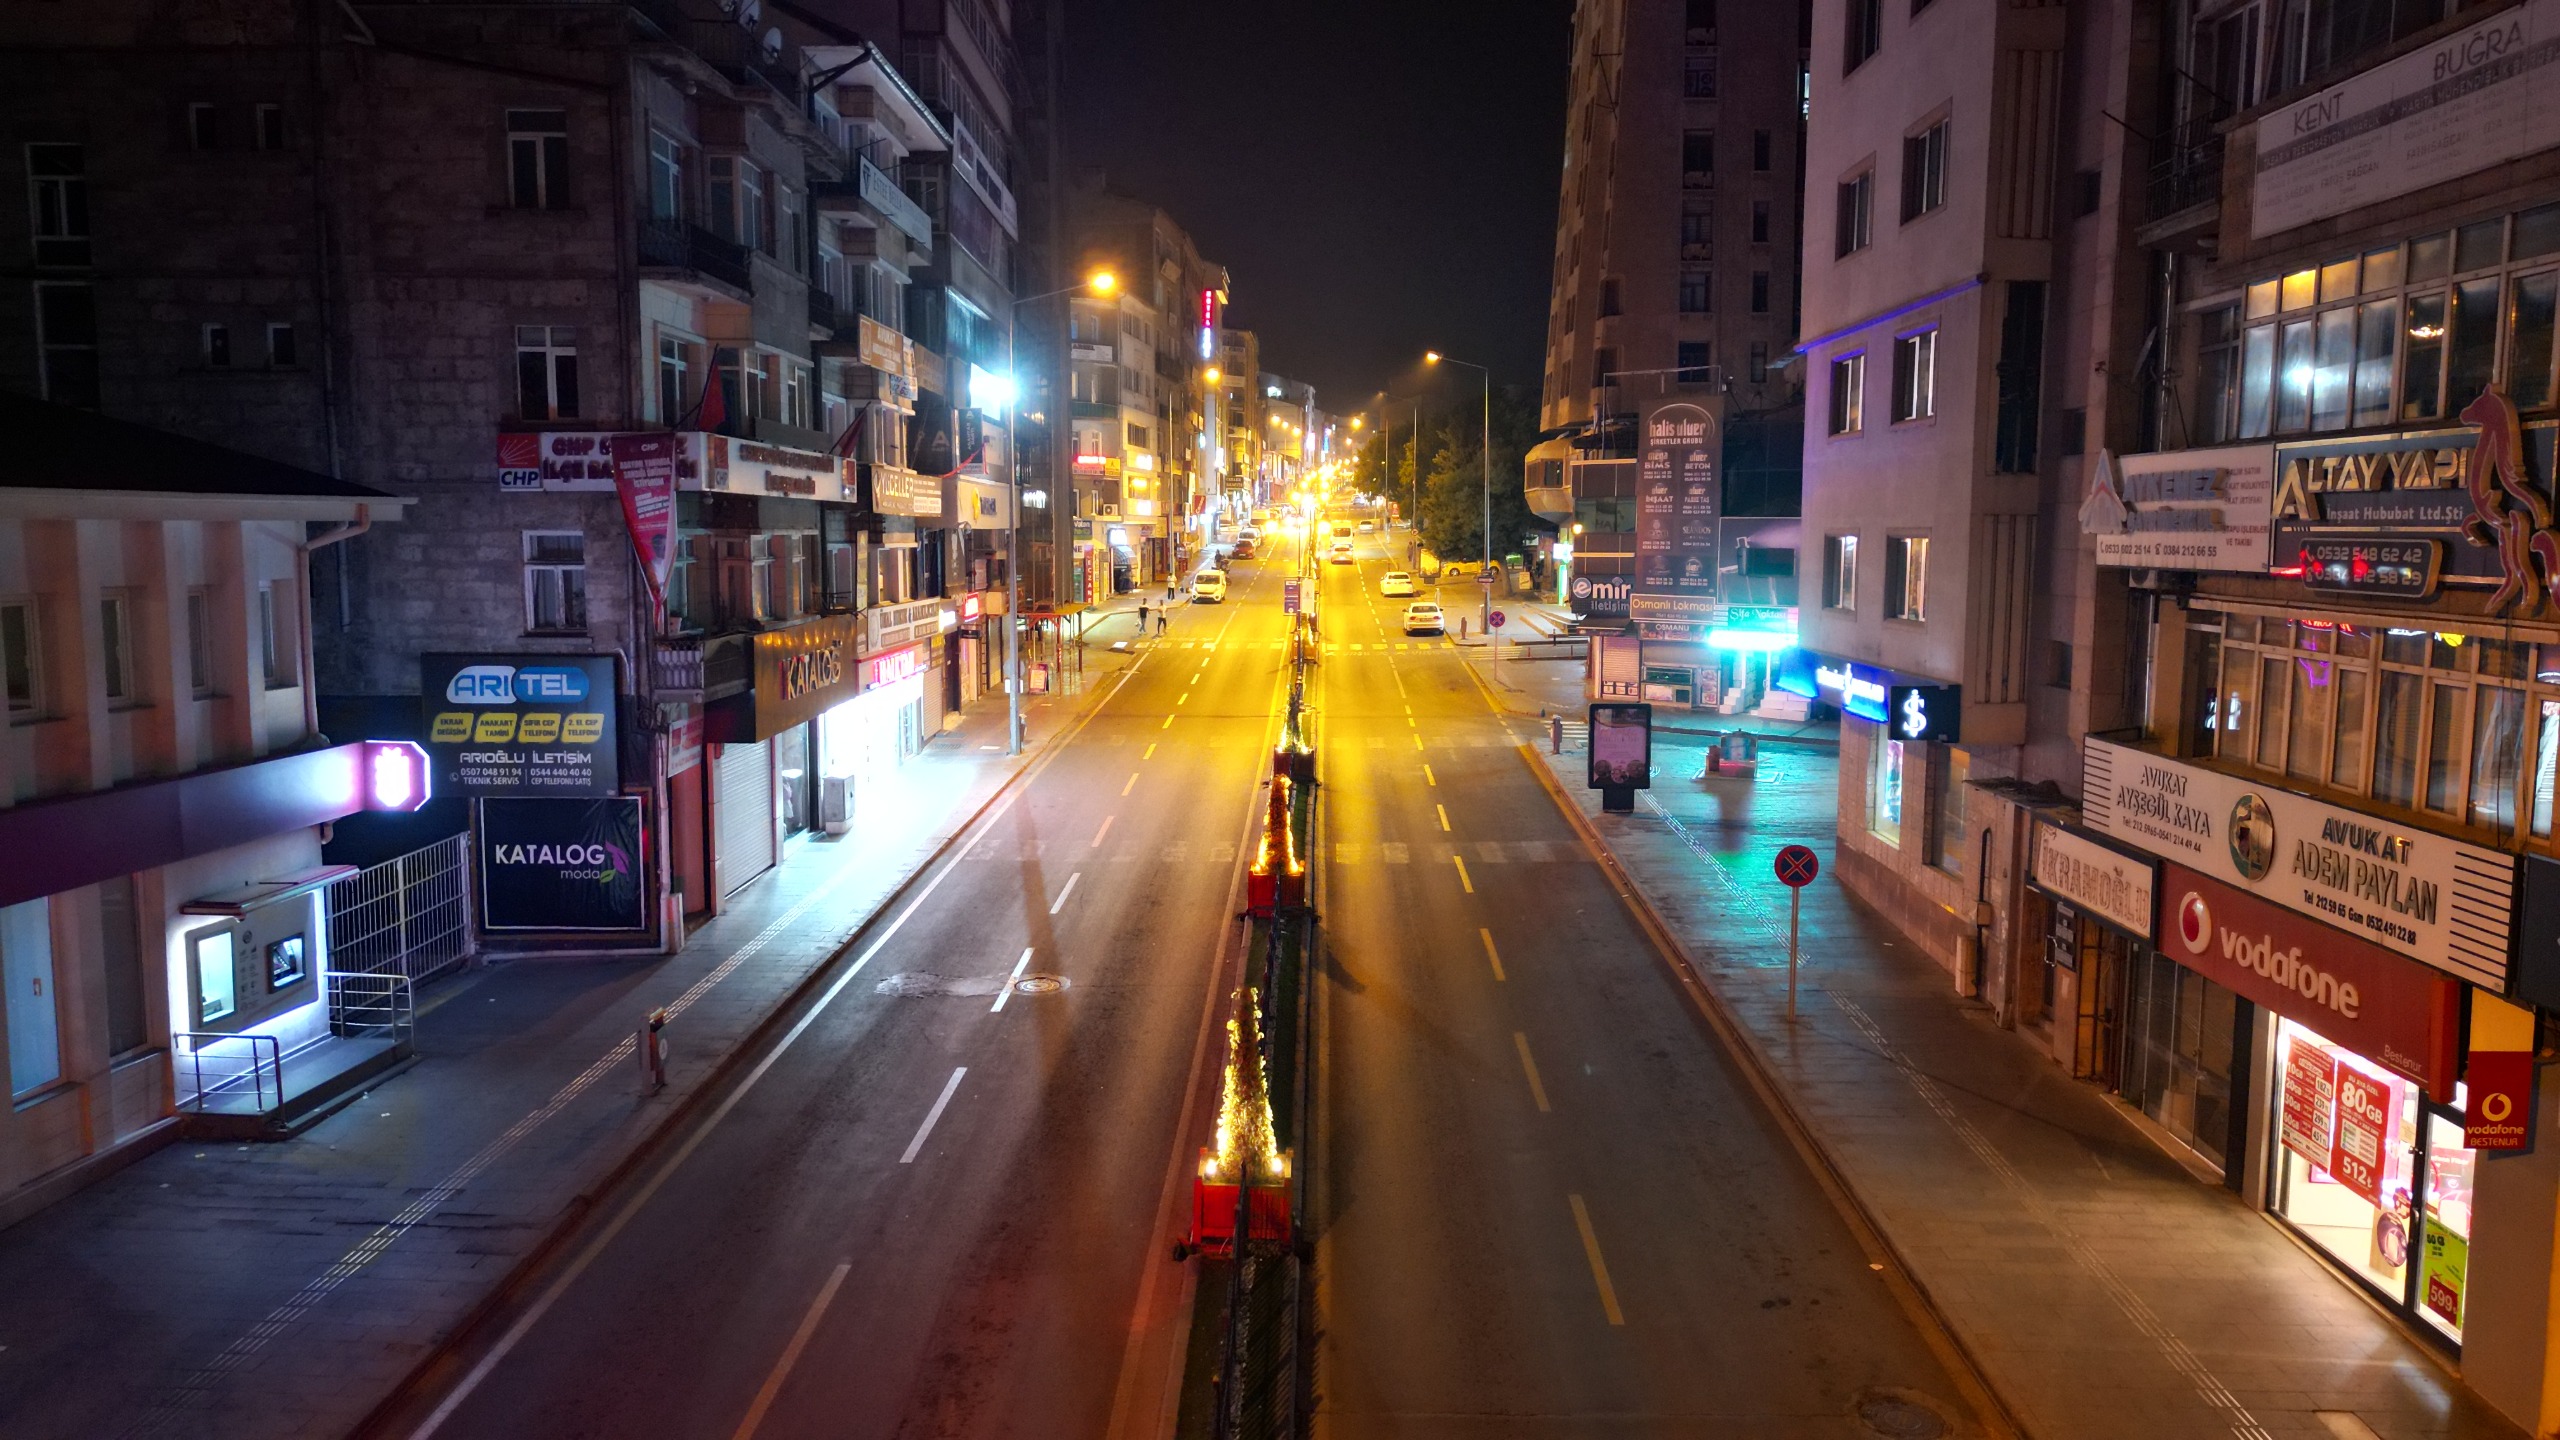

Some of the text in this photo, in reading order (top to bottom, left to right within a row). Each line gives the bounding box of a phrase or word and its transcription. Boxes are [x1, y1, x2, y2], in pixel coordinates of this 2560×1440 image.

[2434, 20, 2524, 81] BUĞRA
[2294, 92, 2344, 136] KENT
[1649, 419, 1675, 437] halis
[641, 443, 658, 451] CHP
[1650, 437, 1703, 446] ŞİRKETLER GRUBU
[501, 471, 539, 485] CHP
[2271, 447, 2471, 520] ALTAY YAPI
[2326, 504, 2464, 524] İnşaat Hububat Ltd.Şti
[2105, 544, 2120, 554] 0533
[2134, 545, 2142, 554] 25
[2143, 545, 2151, 555] 14
[2164, 546, 2181, 556] 0384
[2182, 546, 2195, 556] 212
[2207, 547, 2217, 557] 55
[2317, 546, 2422, 563] 0532 548 62 42
[2380, 570, 2398, 584] 58
[2402, 571, 2422, 586] 29
[1573, 577, 1631, 600] emir
[1632, 599, 1713, 612] Osmanlı Lokması
[784, 647, 842, 700] KATALOG
[460, 750, 592, 765] ARIOĞLU İLETİŞİM
[460, 768, 522, 776] 0507 048 91 94
[530, 768, 592, 776] 0544 440 40 40
[531, 777, 592, 786] CEP TELEFONU SATIŞ
[2140, 765, 2188, 798] AVUKAT
[2116, 785, 2211, 838] AYŞEGÜL KAYA
[2132, 819, 2143, 831] 212
[2173, 834, 2185, 848] 214
[2184, 838, 2193, 849] 49
[2193, 842, 2202, 853] 44
[2321, 816, 2414, 867] AVUKAT
[495, 844, 605, 865] KATALOG
[560, 867, 600, 880] moda
[2292, 839, 2438, 925] ADEM PAYLAN
[2042, 838, 2150, 928] İKRAMOĞLU
[2304, 889, 2314, 905] Tel
[2316, 894, 2328, 911] 212
[2328, 899, 2337, 914] 59
[2338, 903, 2346, 918] 65
[2348, 907, 2364, 925] Gsm
[2366, 914, 2383, 932] 0532
[2383, 921, 2397, 938] 451
[2397, 926, 2406, 942] 22
[2220, 926, 2359, 1019] vodafone
[2384, 1044, 2422, 1073] Bestenur
[2366, 1084, 2379, 1097] ÖZEL
[2467, 1124, 2524, 1135] vodafone
[2470, 1137, 2518, 1146] BESTENUR
